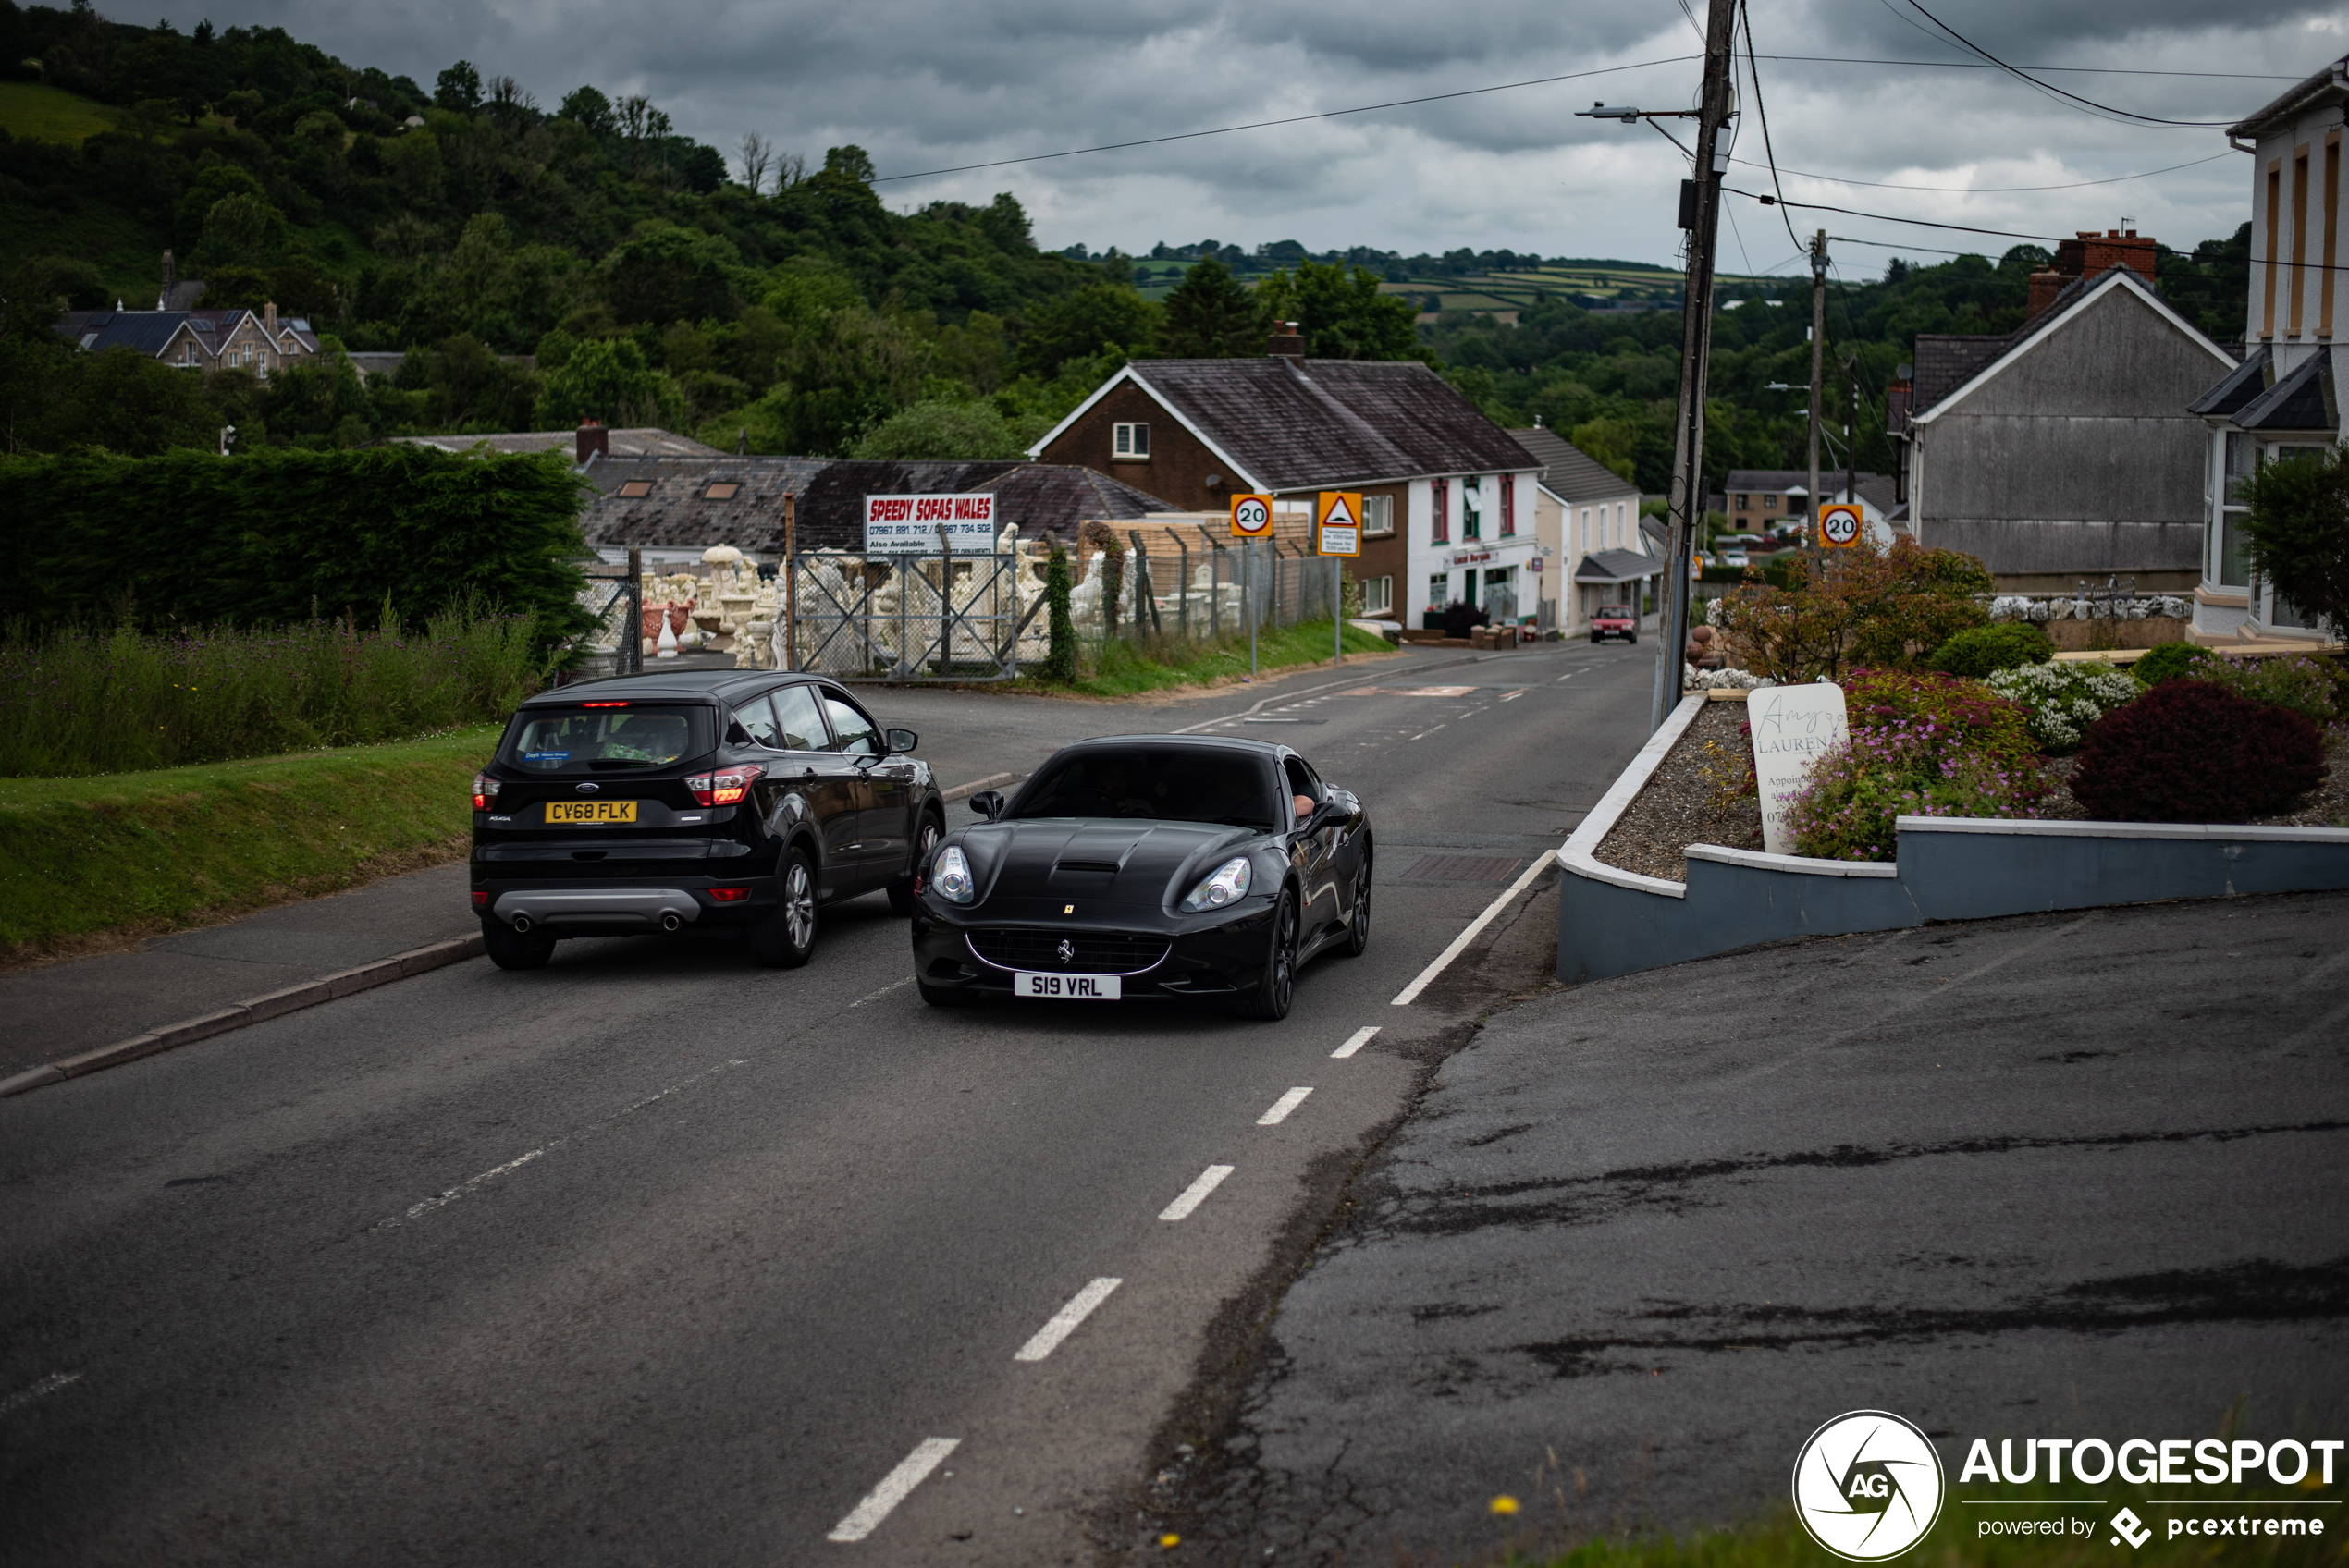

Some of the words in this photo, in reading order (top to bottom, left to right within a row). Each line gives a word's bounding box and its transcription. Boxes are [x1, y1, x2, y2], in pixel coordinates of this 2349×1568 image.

[870, 499, 914, 521] SPEEDY
[916, 498, 953, 521] SOFAS
[954, 497, 991, 520] WALES
[1239, 508, 1265, 522] 20
[869, 525, 893, 535] 07967
[895, 525, 910, 534] 891
[913, 525, 928, 534] 712
[934, 524, 958, 534] 0967
[960, 524, 975, 533] 734
[977, 523, 991, 533] 502
[1828, 519, 1855, 533] 20
[1757, 694, 1824, 740] Amy
[1758, 736, 1828, 753] LAUREN
[553, 804, 594, 819] CV68
[598, 803, 630, 819] FLK
[1032, 976, 1061, 995] S19
[1066, 978, 1102, 997] VRL
